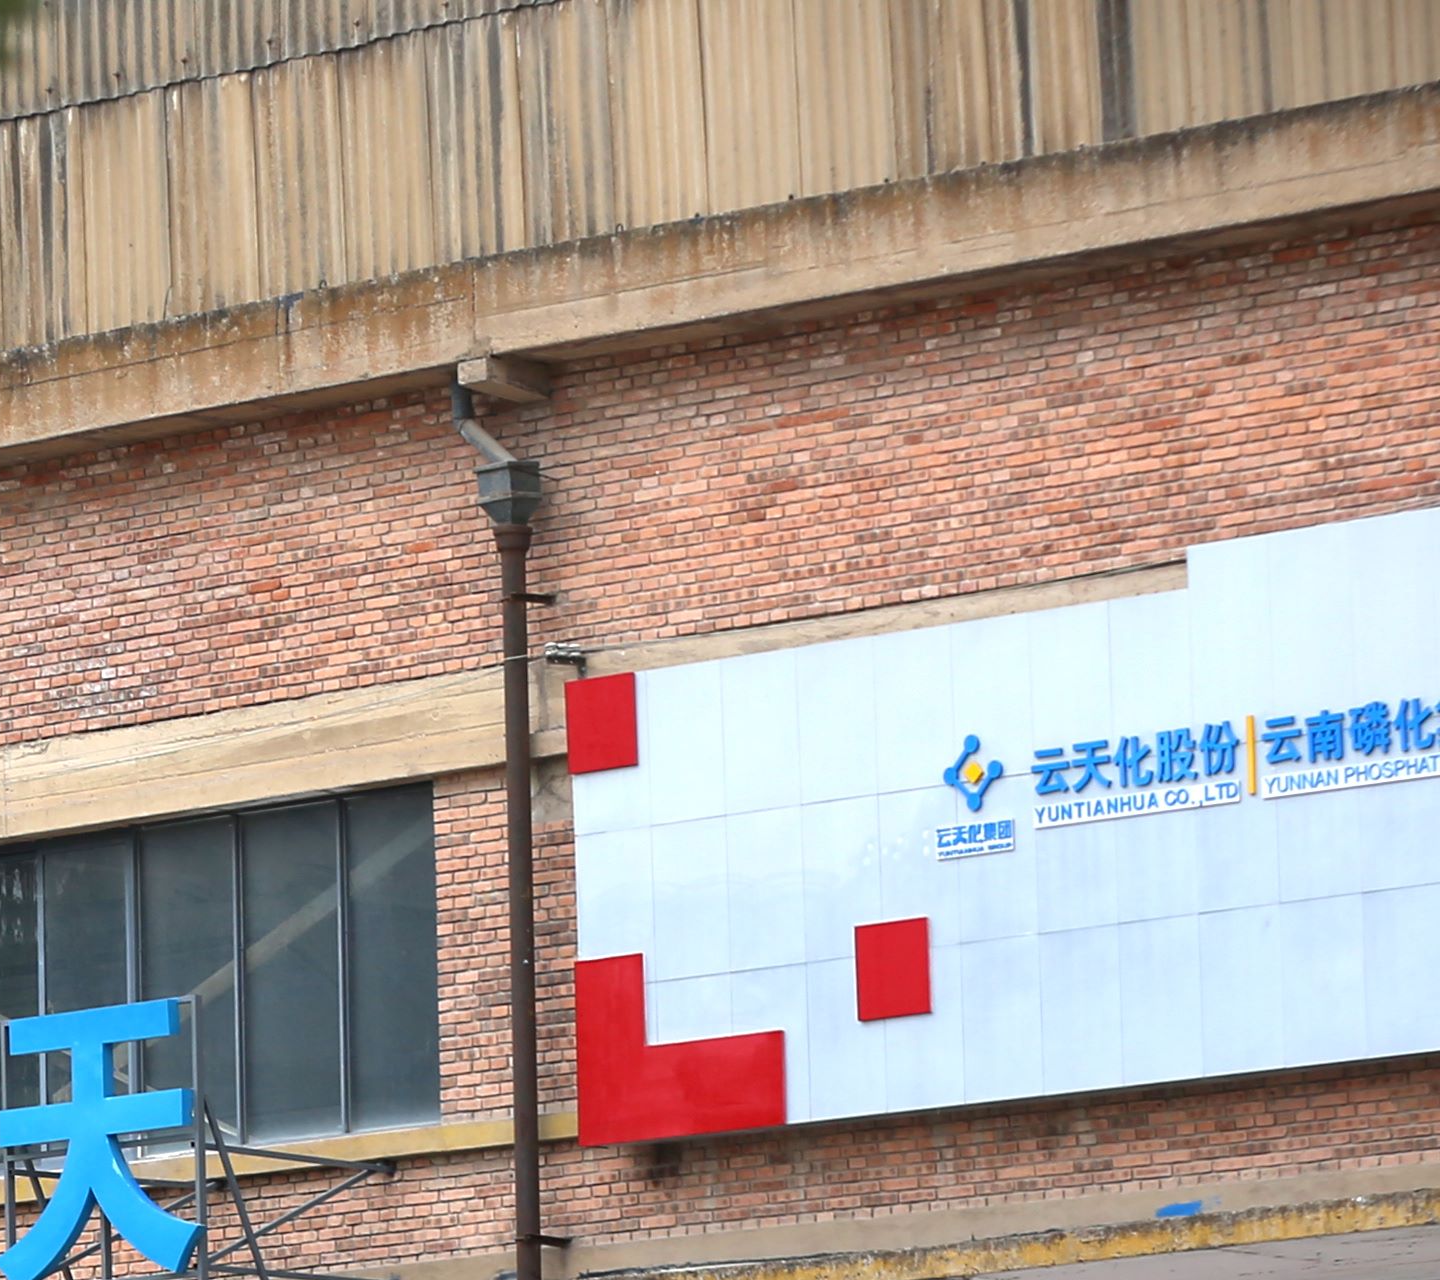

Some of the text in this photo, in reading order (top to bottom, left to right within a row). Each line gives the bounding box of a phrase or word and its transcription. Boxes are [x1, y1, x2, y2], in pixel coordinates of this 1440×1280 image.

[1031, 698, 1440, 797] 云天化股份 云南磷化
[1265, 768, 1339, 794] YUNNAN
[1035, 792, 1158, 824] YUNTIANHUA
[936, 820, 1012, 848] 云天化集团
